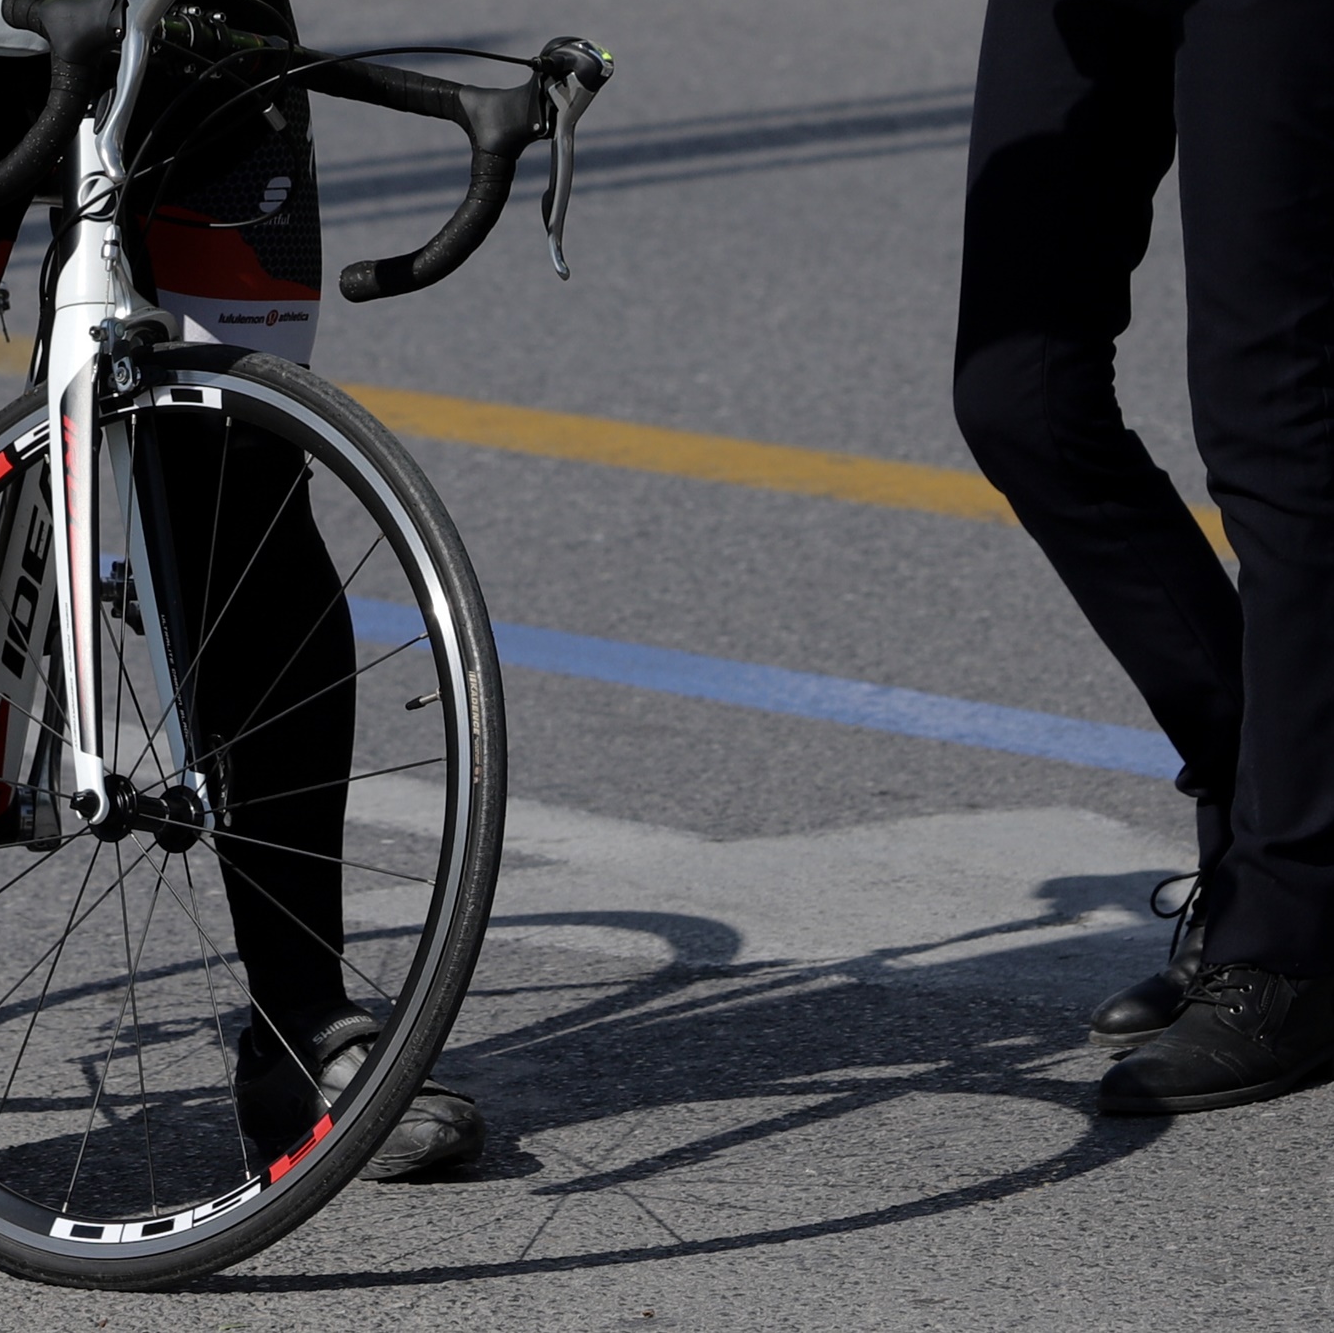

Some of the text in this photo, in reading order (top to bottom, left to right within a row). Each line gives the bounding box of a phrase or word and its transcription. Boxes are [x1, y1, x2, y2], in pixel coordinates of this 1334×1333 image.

[218, 311, 310, 325] lululemon athletica
[470, 683, 481, 736] KADENCE
[312, 1015, 374, 1046] SHIMANO
